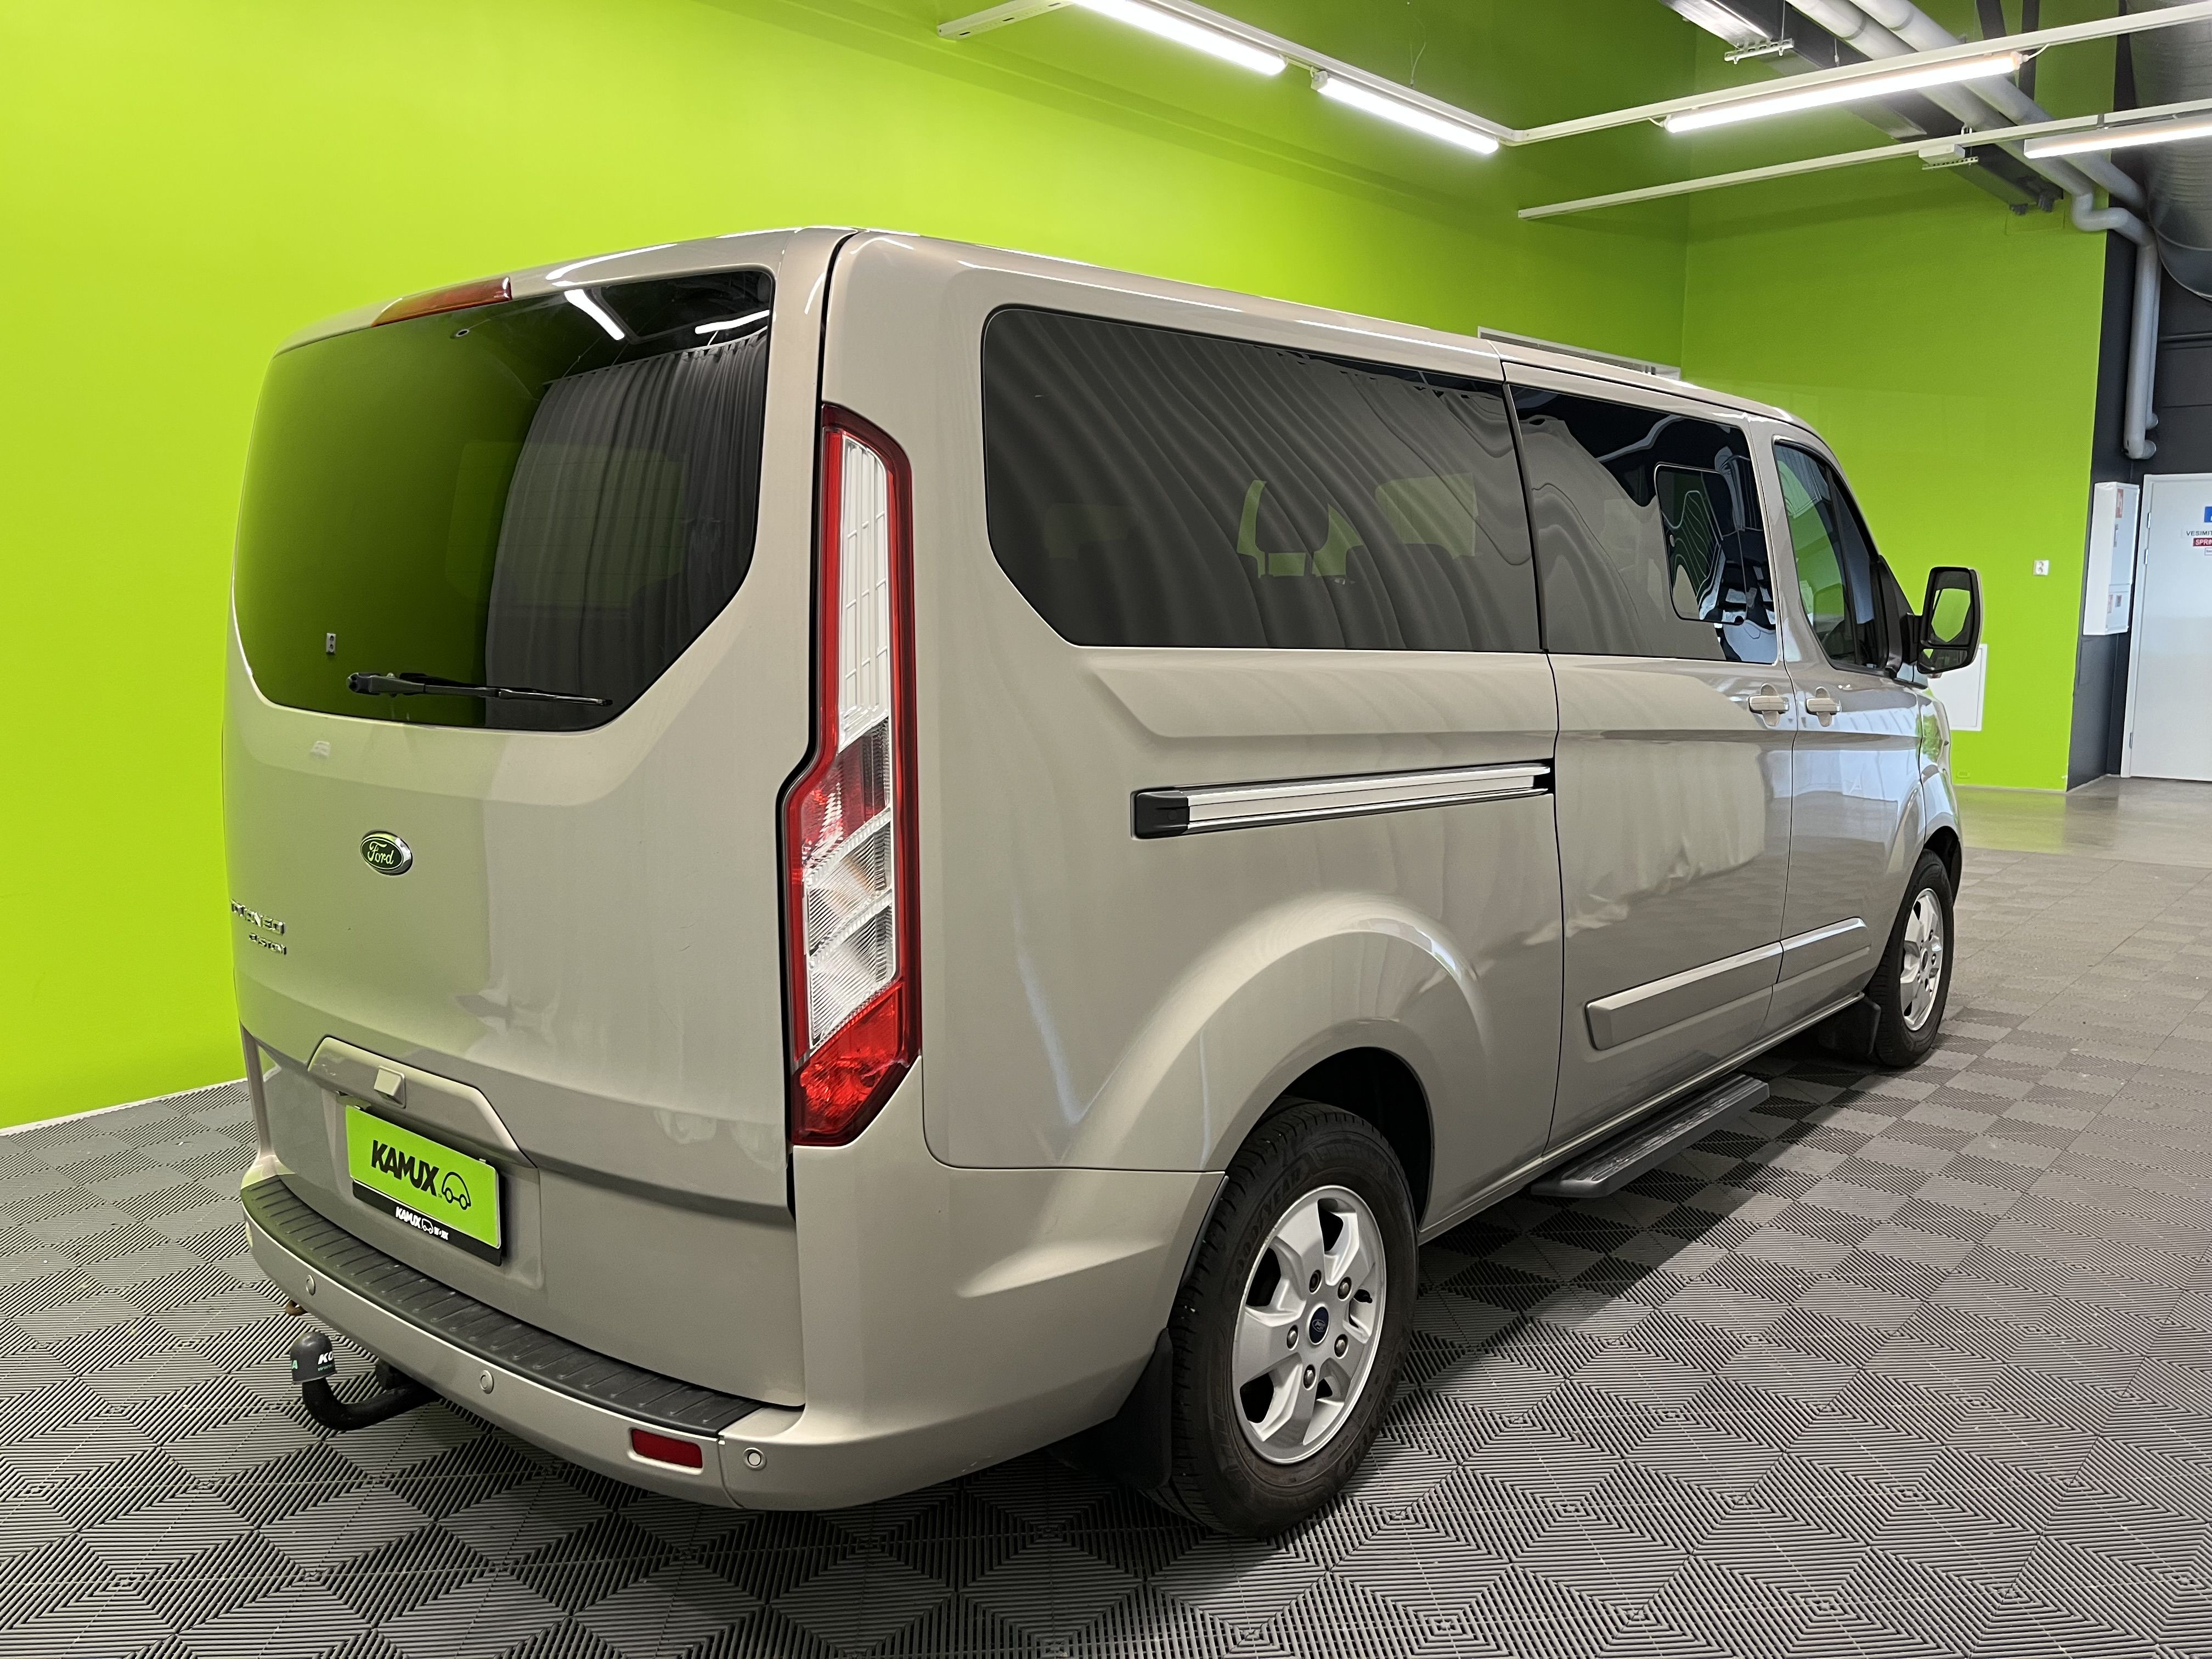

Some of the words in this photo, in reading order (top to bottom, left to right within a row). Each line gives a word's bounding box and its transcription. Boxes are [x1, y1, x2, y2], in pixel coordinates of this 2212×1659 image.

[367, 841, 394, 865] Ford
[371, 1139, 439, 1197] KAMUX
[396, 1206, 421, 1229] KAMUX
